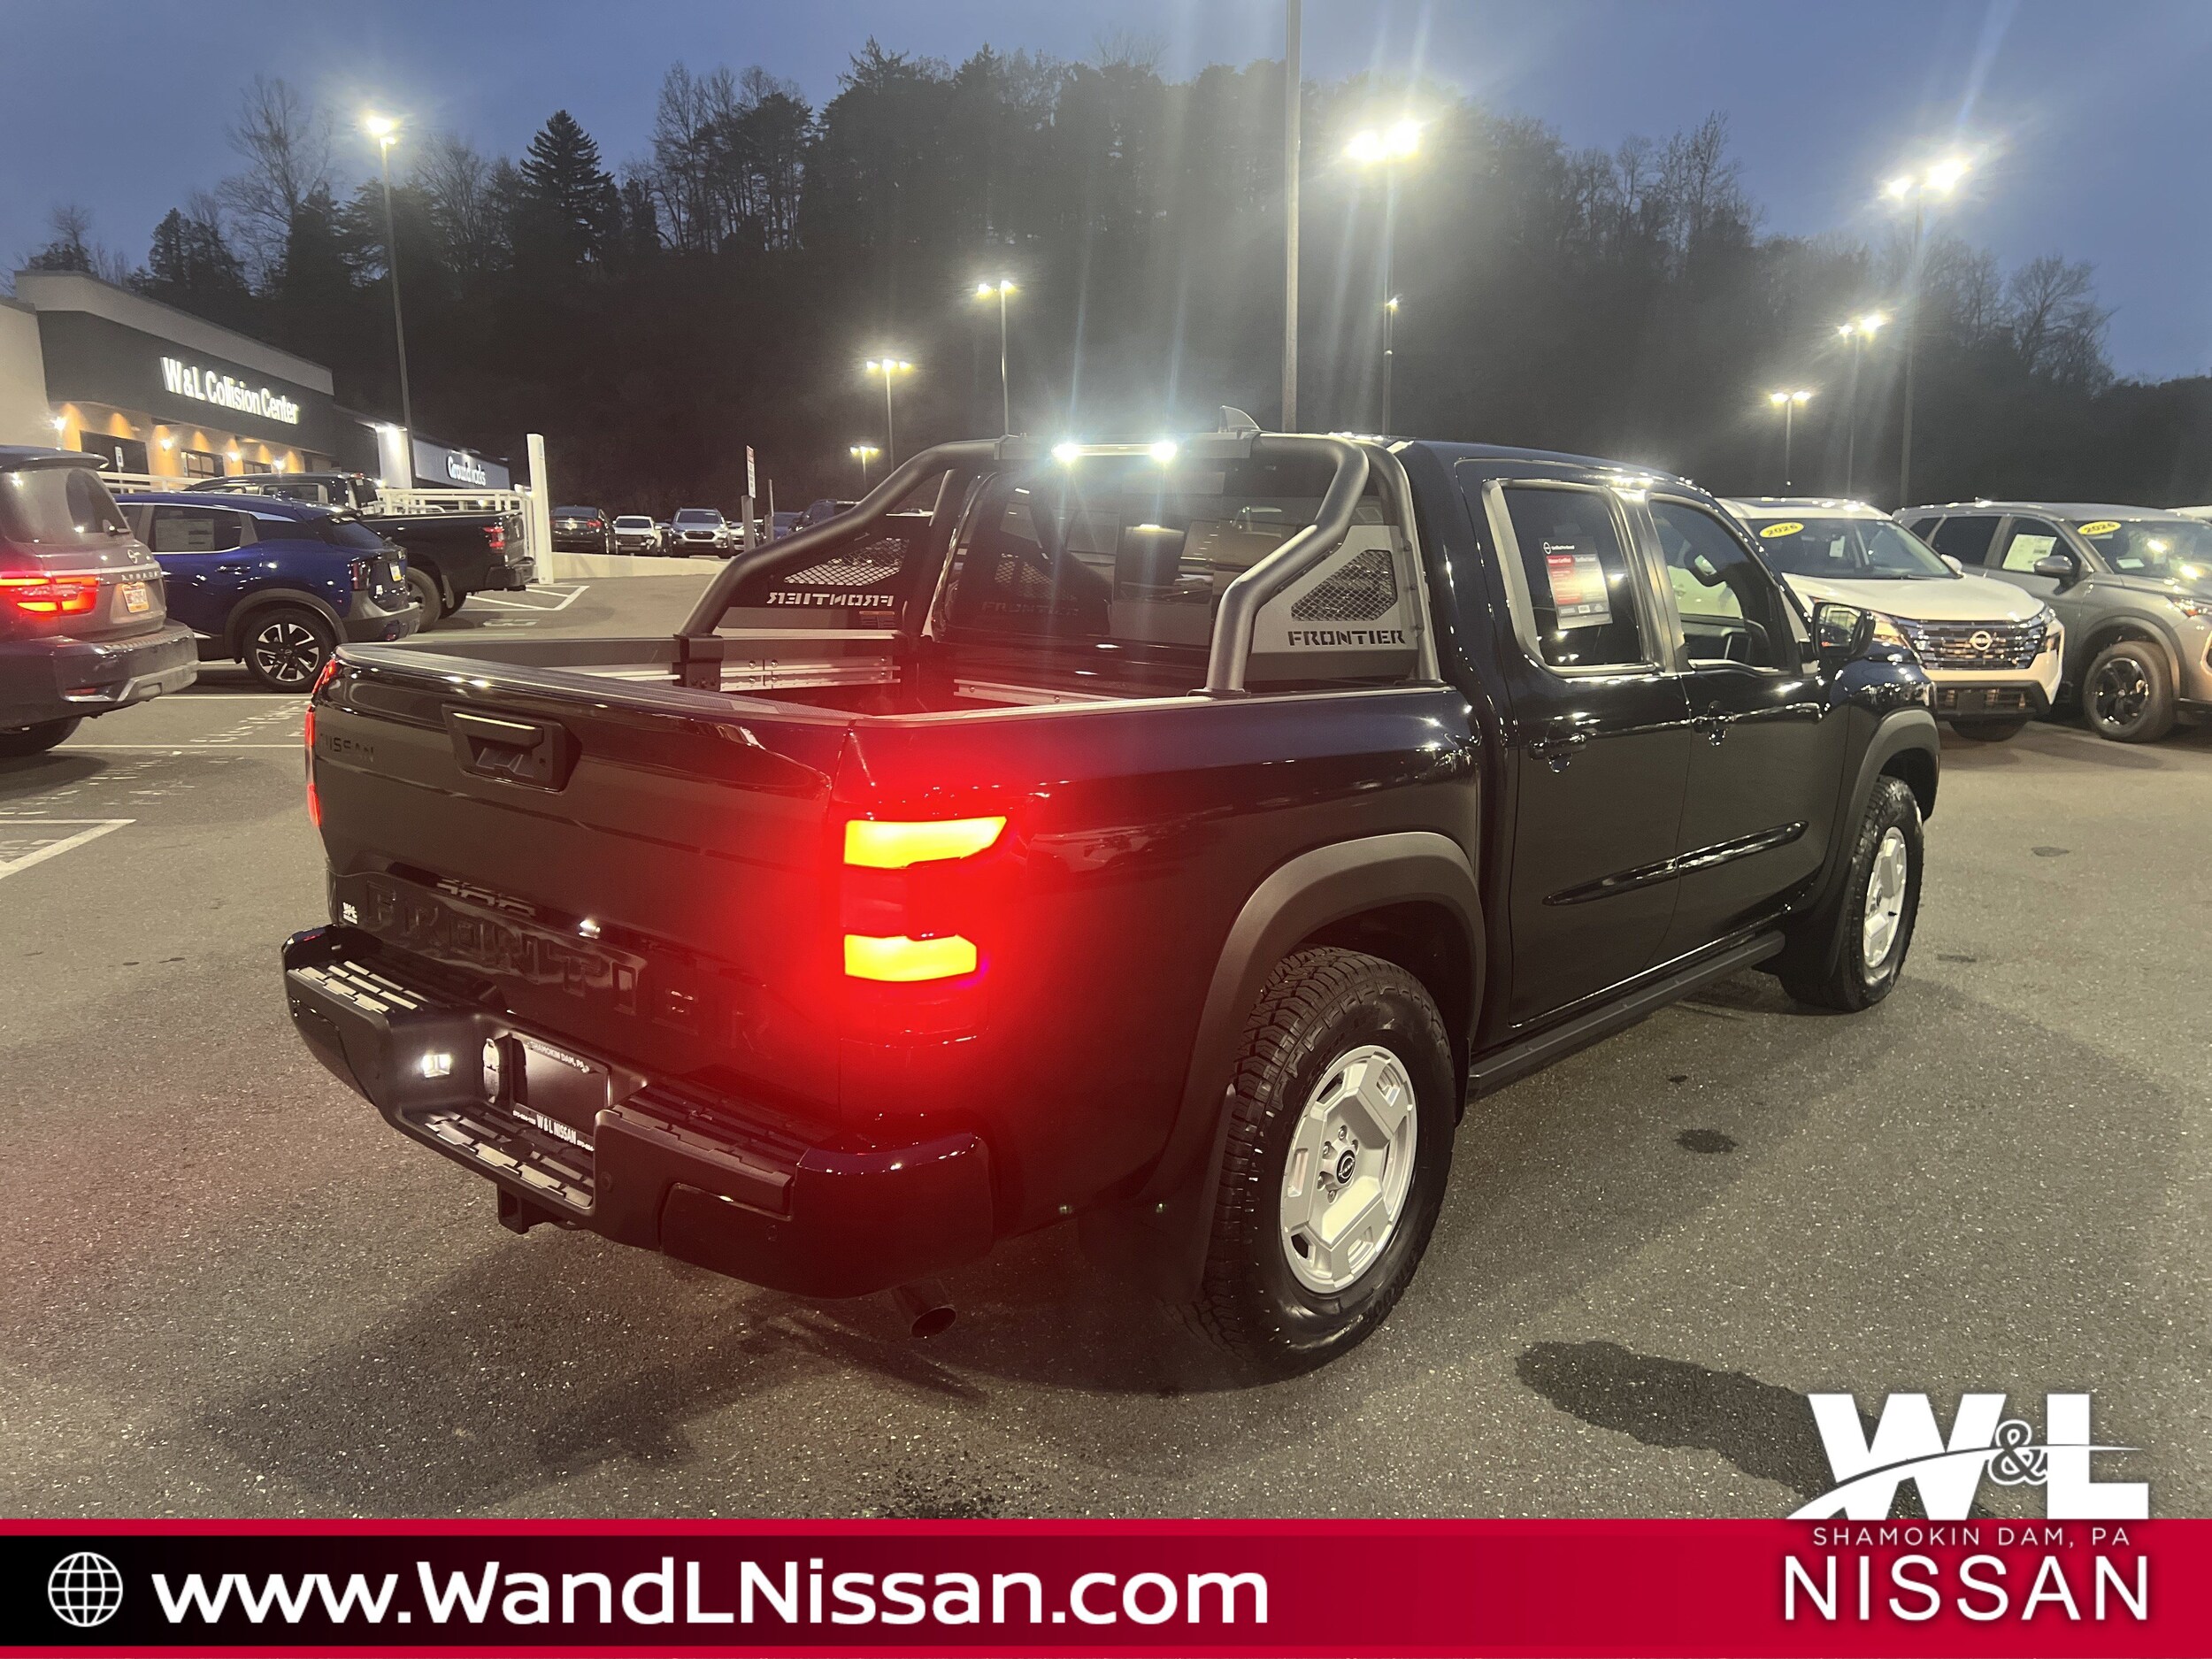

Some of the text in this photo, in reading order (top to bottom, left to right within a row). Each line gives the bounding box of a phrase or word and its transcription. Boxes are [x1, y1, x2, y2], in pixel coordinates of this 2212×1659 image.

[160, 357, 300, 425] W&L Collision Center
[1287, 630, 1406, 646] FRONTIER
[536, 1114, 544, 1130] W
[553, 1121, 577, 1145] NISSAN
